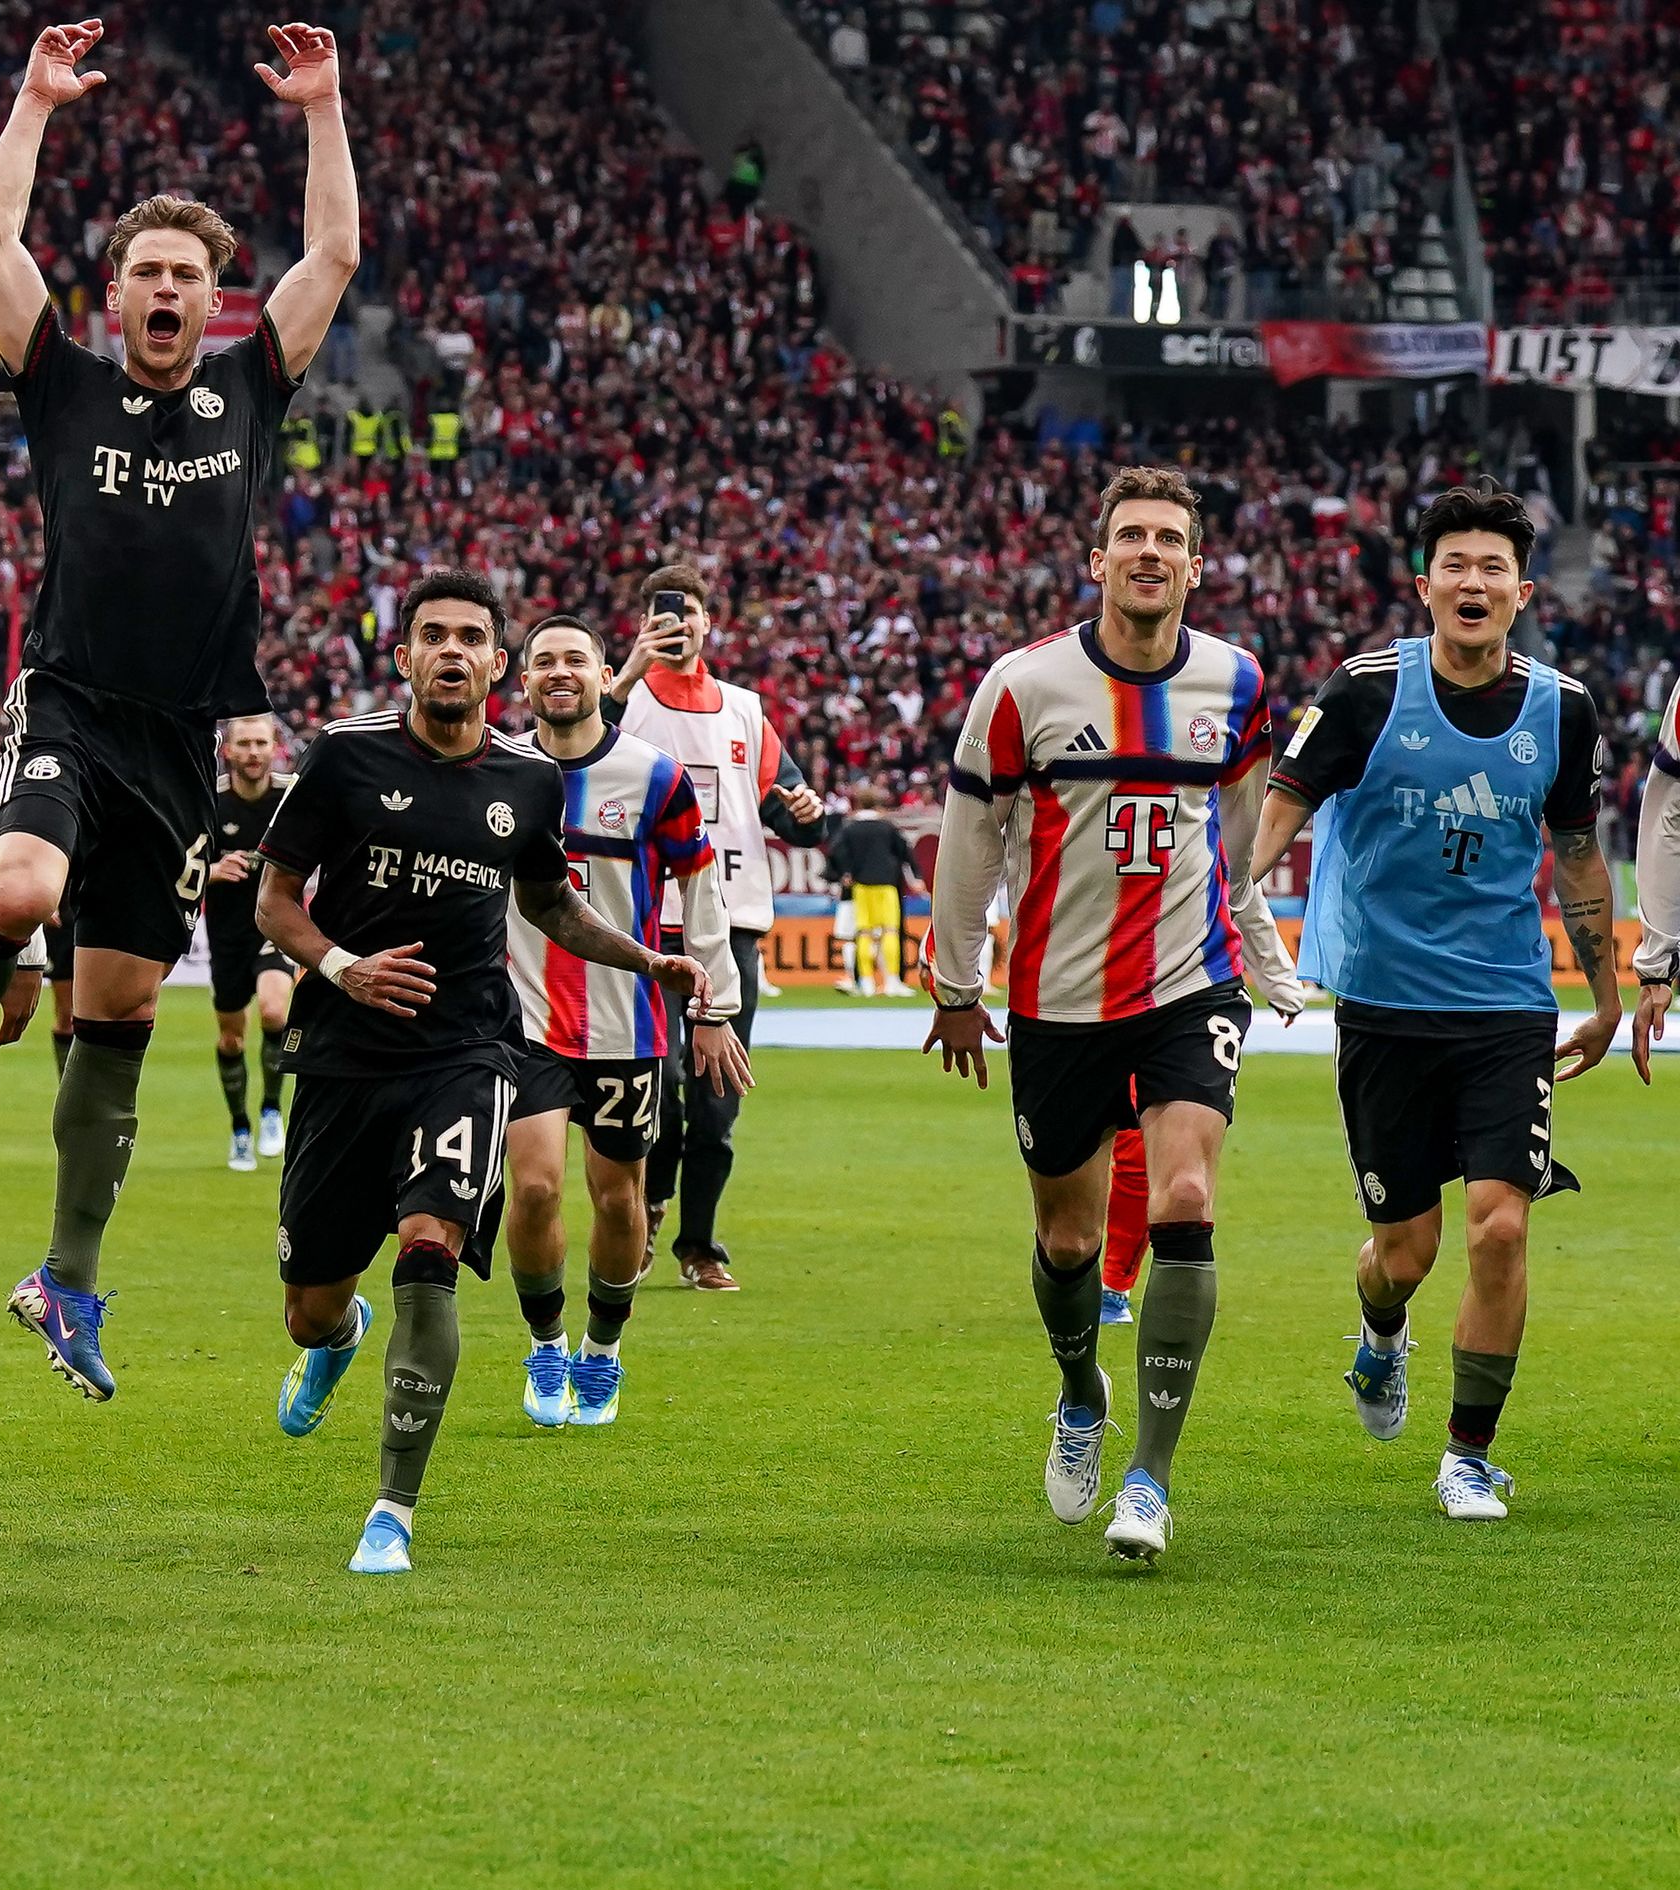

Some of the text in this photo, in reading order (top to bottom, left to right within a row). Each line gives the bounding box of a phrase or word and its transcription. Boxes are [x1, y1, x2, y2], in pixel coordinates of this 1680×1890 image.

[93, 445, 241, 495] T MAGENTA
[143, 482, 175, 507] TV
[1105, 793, 1179, 876] T
[1442, 827, 1485, 876] T
[175, 833, 209, 900] 6
[368, 845, 504, 890] T MAGENTA
[411, 873, 441, 897] TV
[1207, 1014, 1241, 1071] 8
[407, 1116, 472, 1181] 14
[392, 1376, 441, 1395] FCBM
[1145, 1356, 1192, 1371] FCBM
